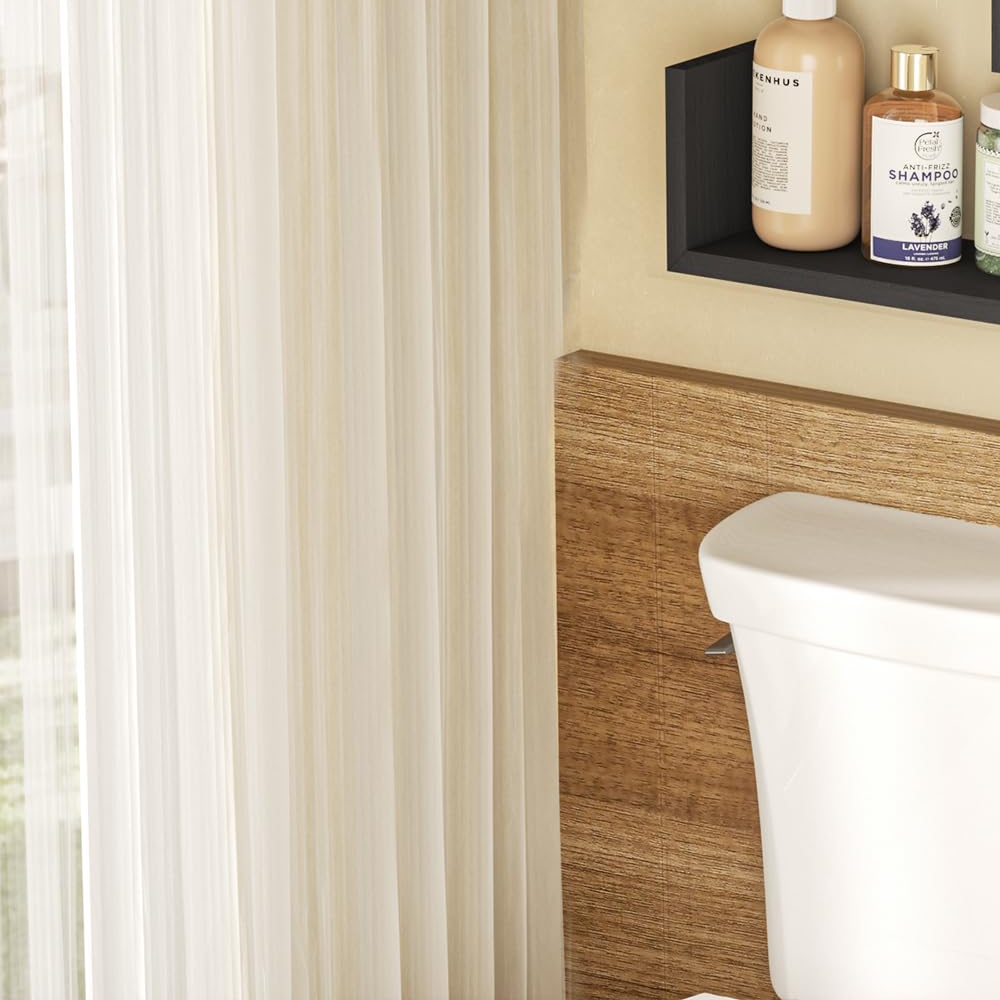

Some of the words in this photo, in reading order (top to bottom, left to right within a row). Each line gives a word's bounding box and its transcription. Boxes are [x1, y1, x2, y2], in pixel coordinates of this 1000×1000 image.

[753, 120, 772, 134] OTION
[903, 162, 951, 171] ANTI-FRIZZ
[888, 168, 959, 182] SHAMPOO
[902, 242, 949, 251] LAVENDER
